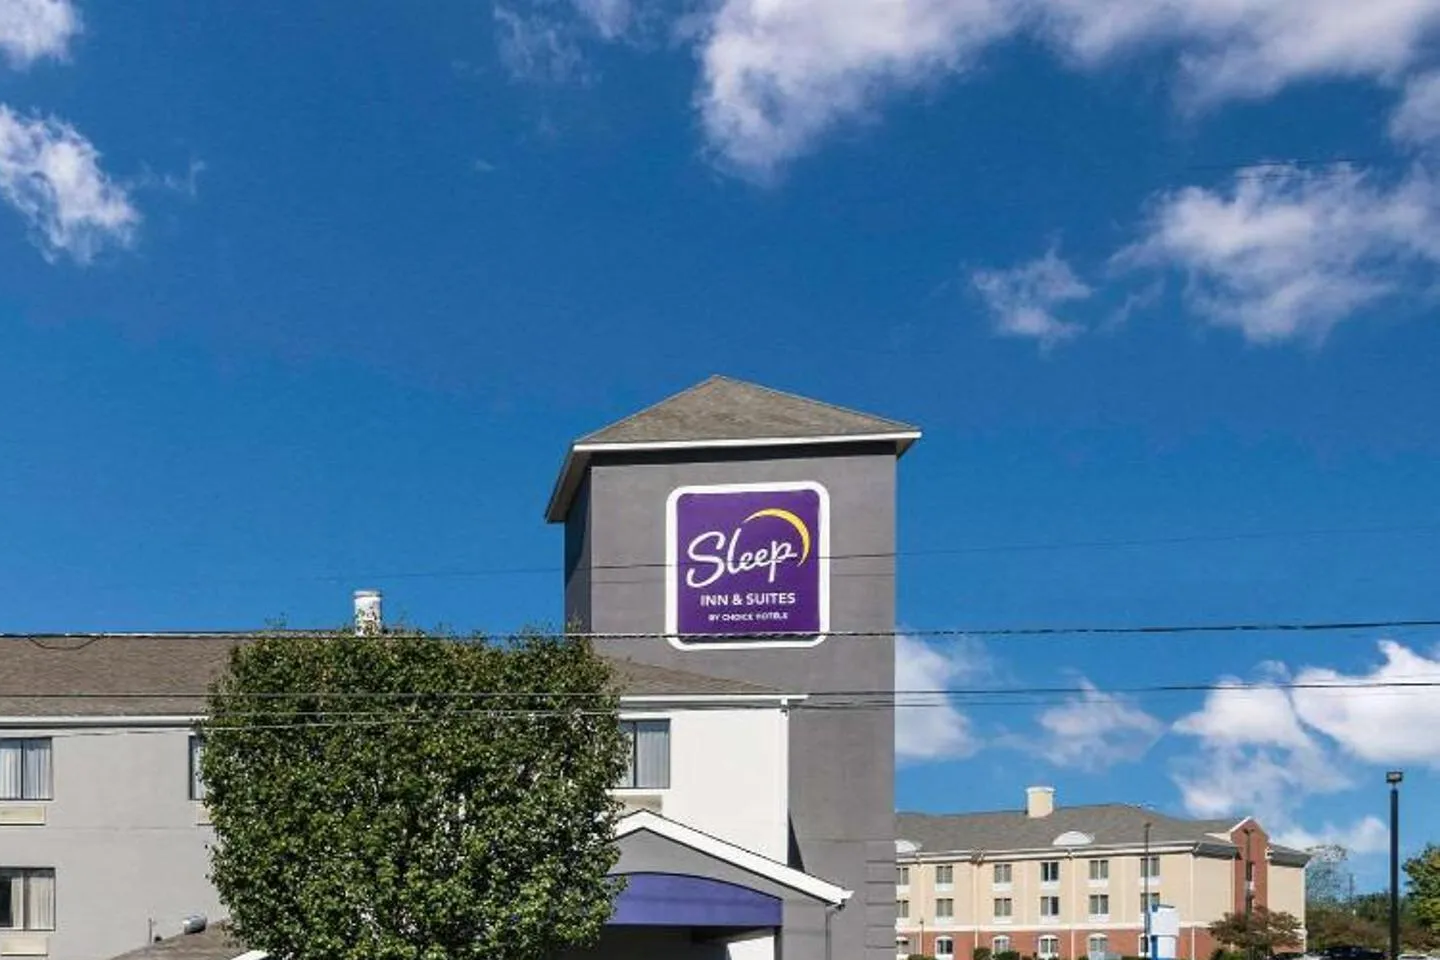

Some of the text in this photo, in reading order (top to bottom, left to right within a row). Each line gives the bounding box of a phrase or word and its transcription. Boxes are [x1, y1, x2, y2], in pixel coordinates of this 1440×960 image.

[686, 528, 797, 588] Sleep
[700, 592, 796, 606] INN & SUITES
